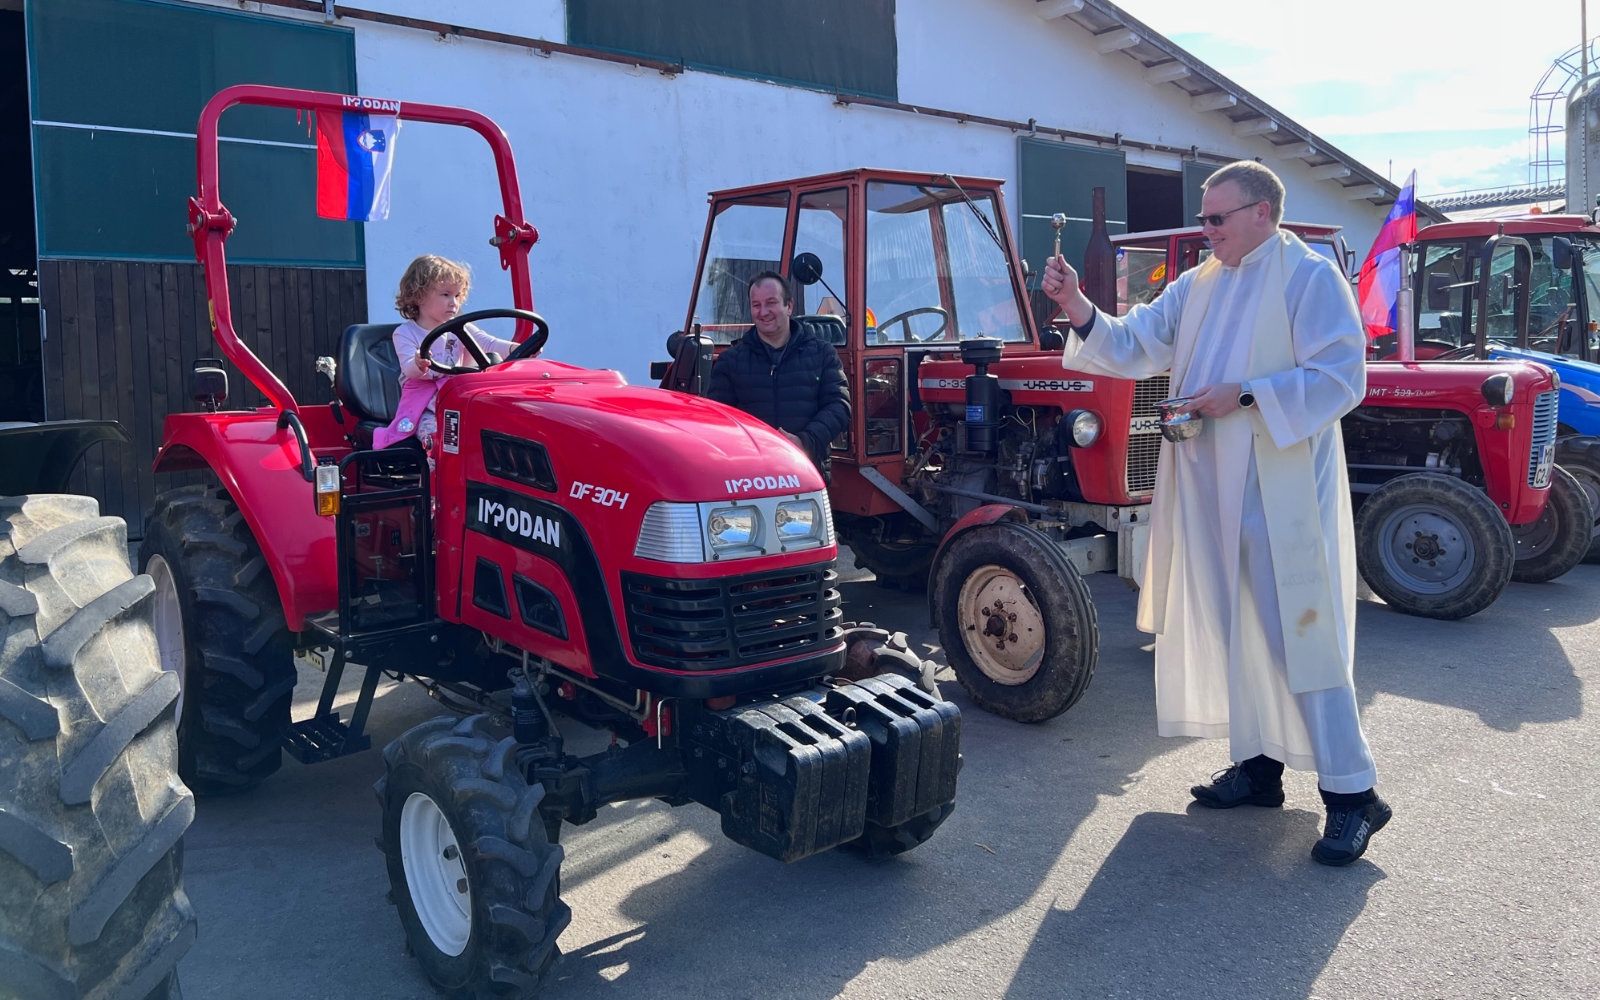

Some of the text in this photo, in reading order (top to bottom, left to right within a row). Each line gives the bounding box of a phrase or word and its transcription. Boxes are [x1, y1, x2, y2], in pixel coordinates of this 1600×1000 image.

[939, 380, 966, 388] C-33
[1024, 380, 1085, 391] URSUS
[1132, 420, 1161, 430] URS
[725, 475, 800, 494] IMPODAN
[478, 497, 560, 548] IMPODAN
[1352, 818, 1370, 852] ALPIN
